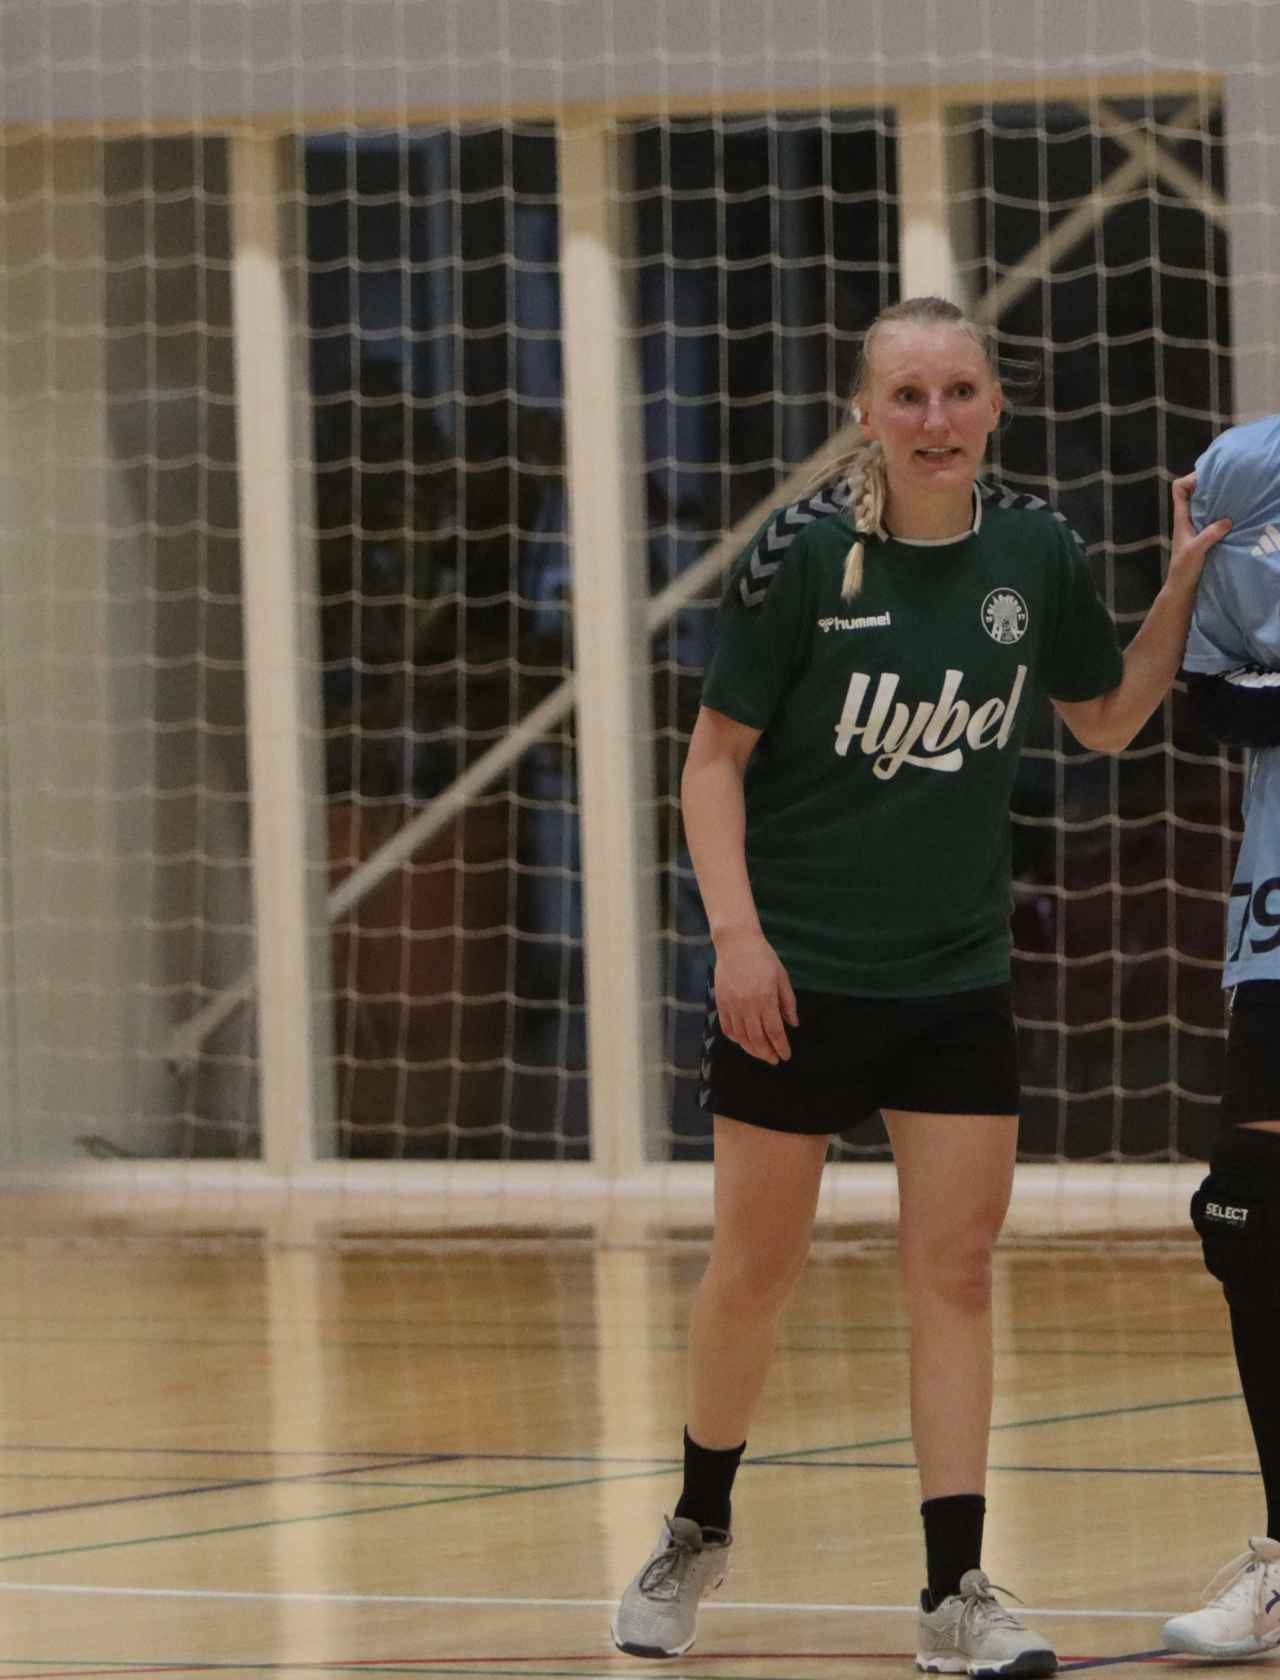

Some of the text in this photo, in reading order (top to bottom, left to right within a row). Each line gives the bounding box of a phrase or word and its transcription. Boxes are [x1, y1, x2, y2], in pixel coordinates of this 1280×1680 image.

[835, 611, 891, 631] hummel
[834, 664, 1028, 781] Hybel
[1206, 1203, 1248, 1221] SELECT
